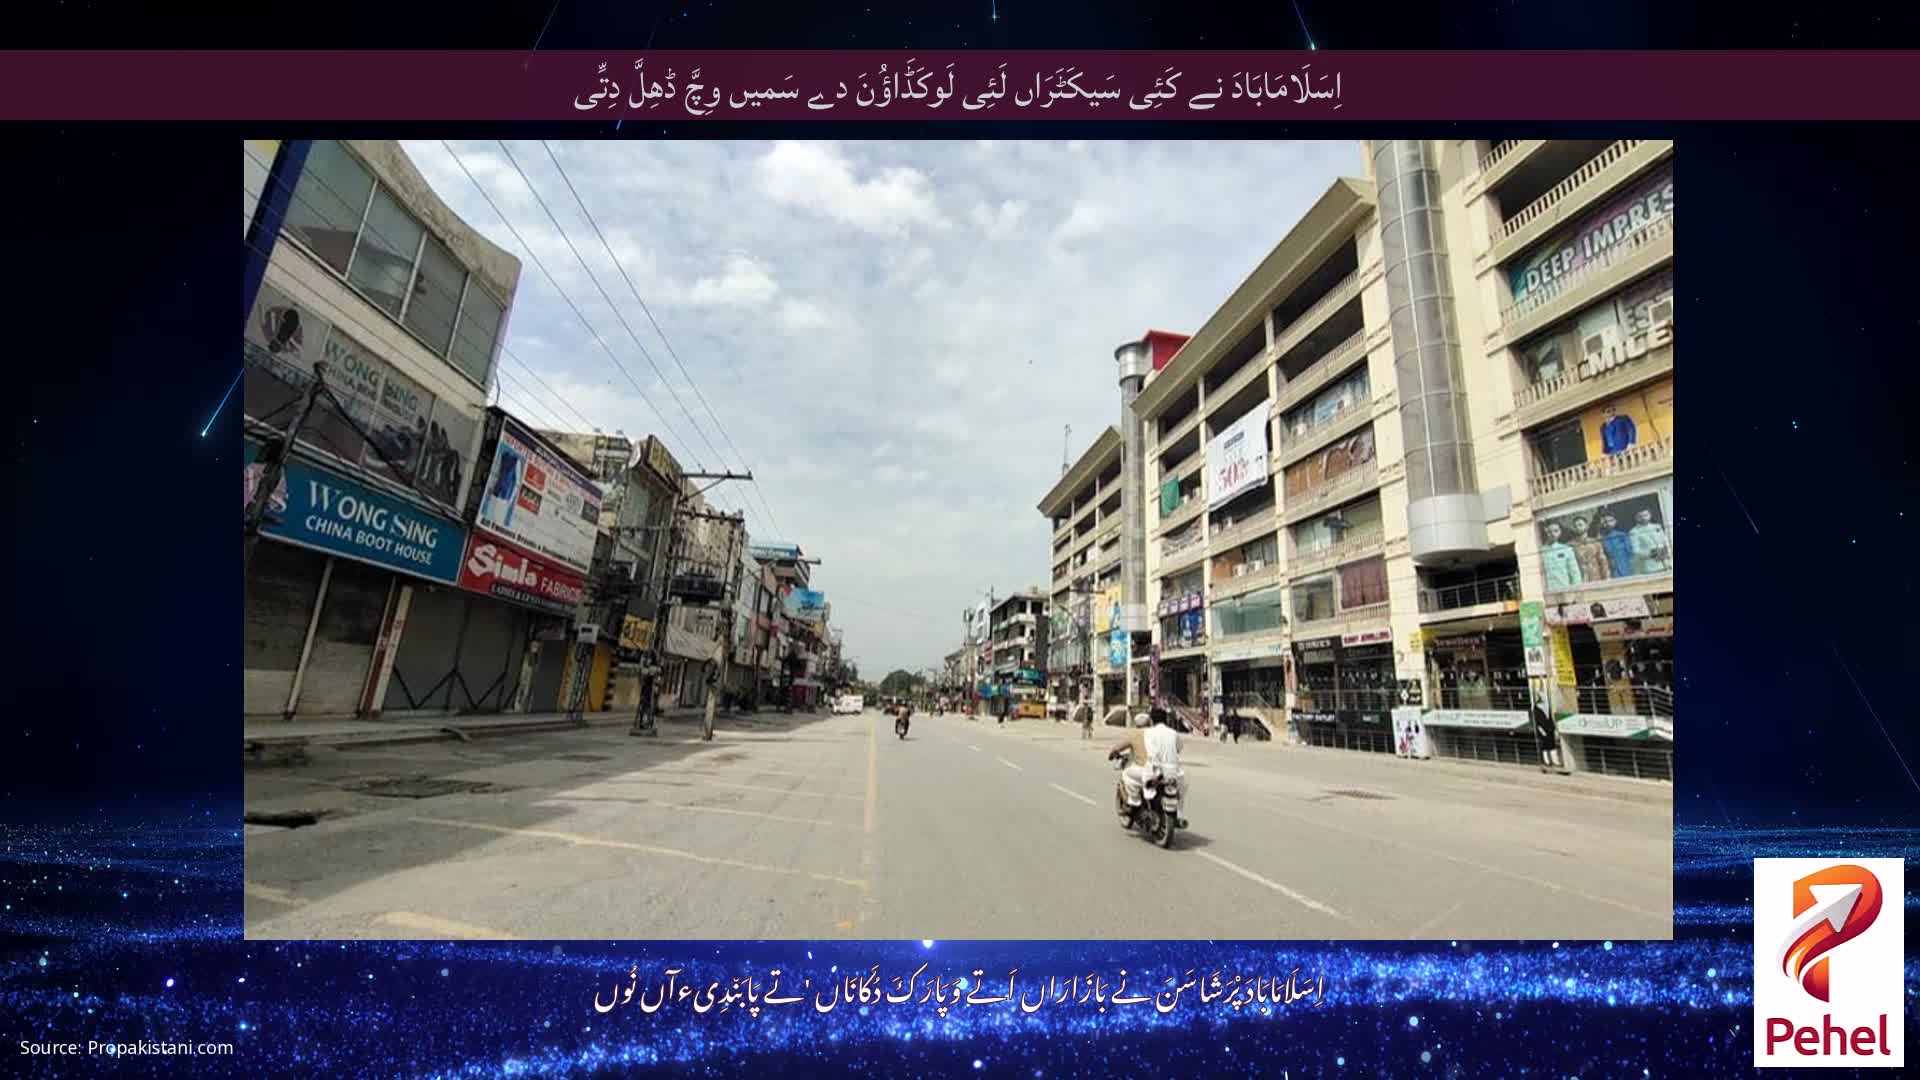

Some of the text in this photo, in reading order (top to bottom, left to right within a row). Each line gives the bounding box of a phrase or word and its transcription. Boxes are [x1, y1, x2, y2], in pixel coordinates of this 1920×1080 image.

[1526, 246, 1575, 291] DEEP
[309, 479, 439, 549] WONG SING
[305, 515, 433, 566] CHINA BOOT HOUSE
